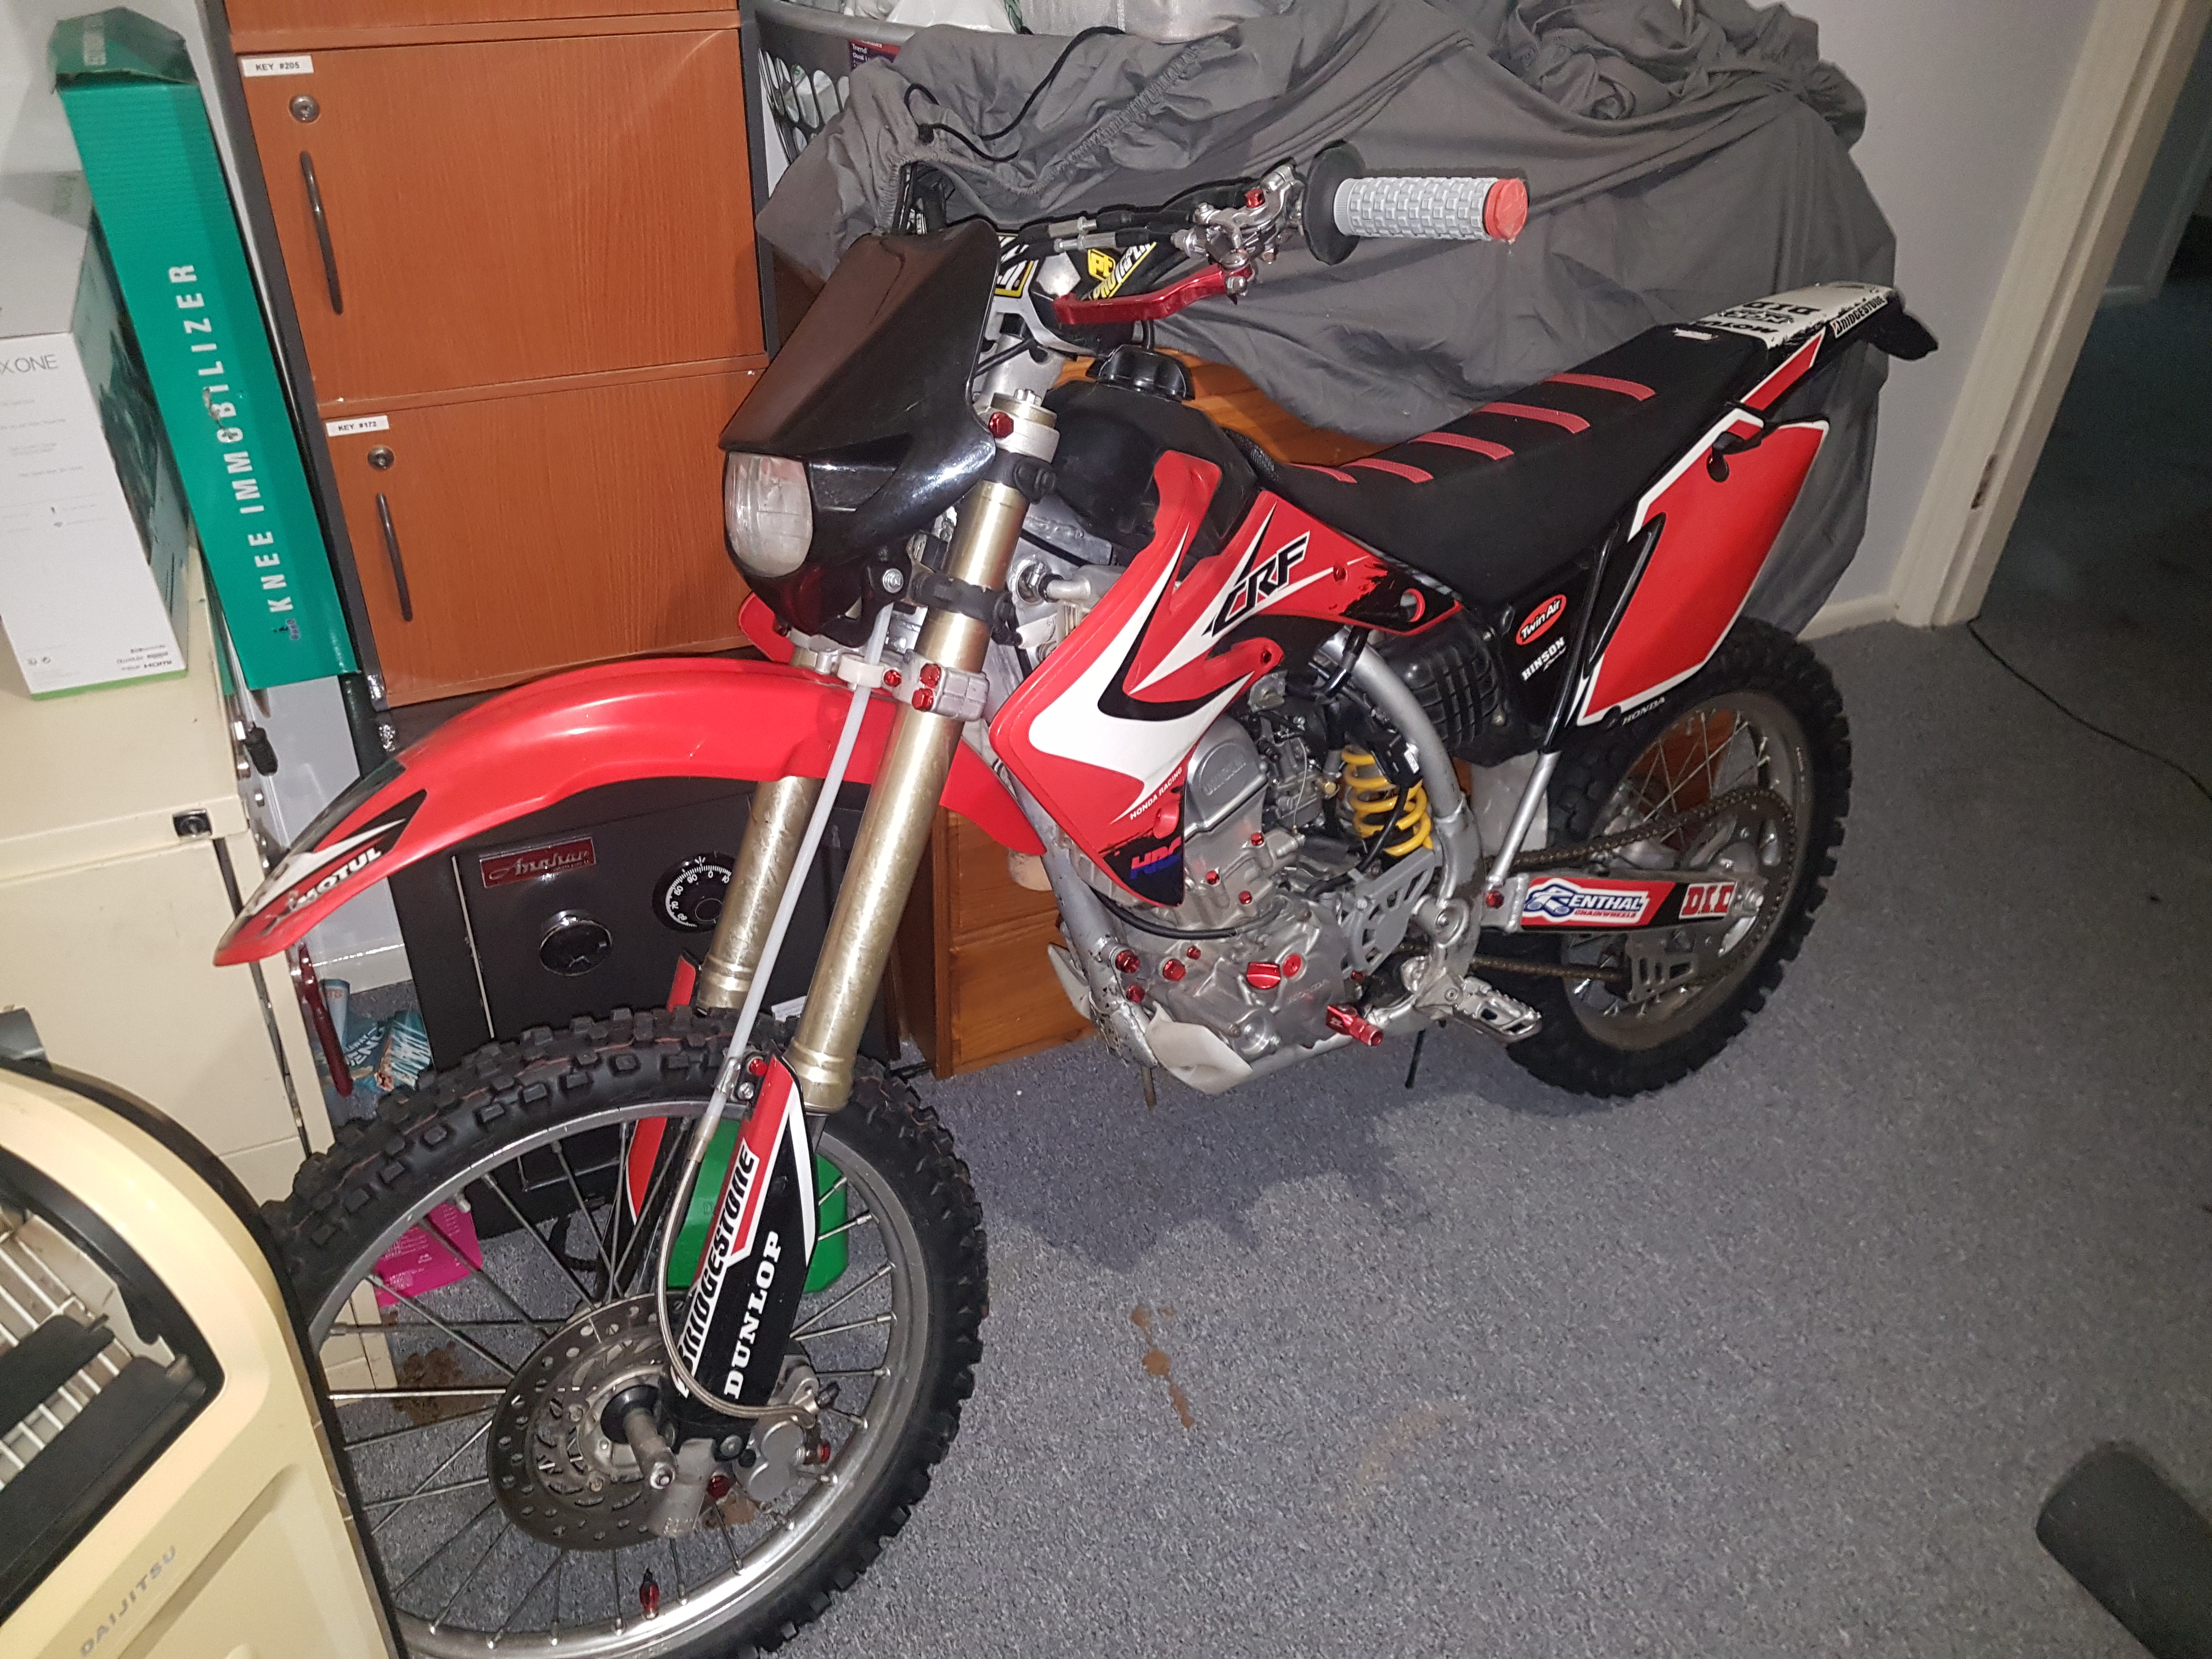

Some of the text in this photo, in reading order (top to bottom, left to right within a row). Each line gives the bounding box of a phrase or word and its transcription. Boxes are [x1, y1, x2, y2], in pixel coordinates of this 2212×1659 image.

[168, 264, 294, 613] KNEE IMMOBILIZER
[338, 424, 354, 432] KEY
[1201, 530, 1310, 637] CRF
[1520, 599, 1562, 640] Twin Air
[1521, 636, 1565, 681] HINSON
[1622, 696, 1666, 726] HONDA
[1130, 766, 1183, 820] HONDA RACING
[673, 884, 684, 896] 80
[686, 873, 698, 884] 90
[724, 1231, 782, 1400] DUNLOP
[80, 1544, 178, 1657] DAIJITSU
